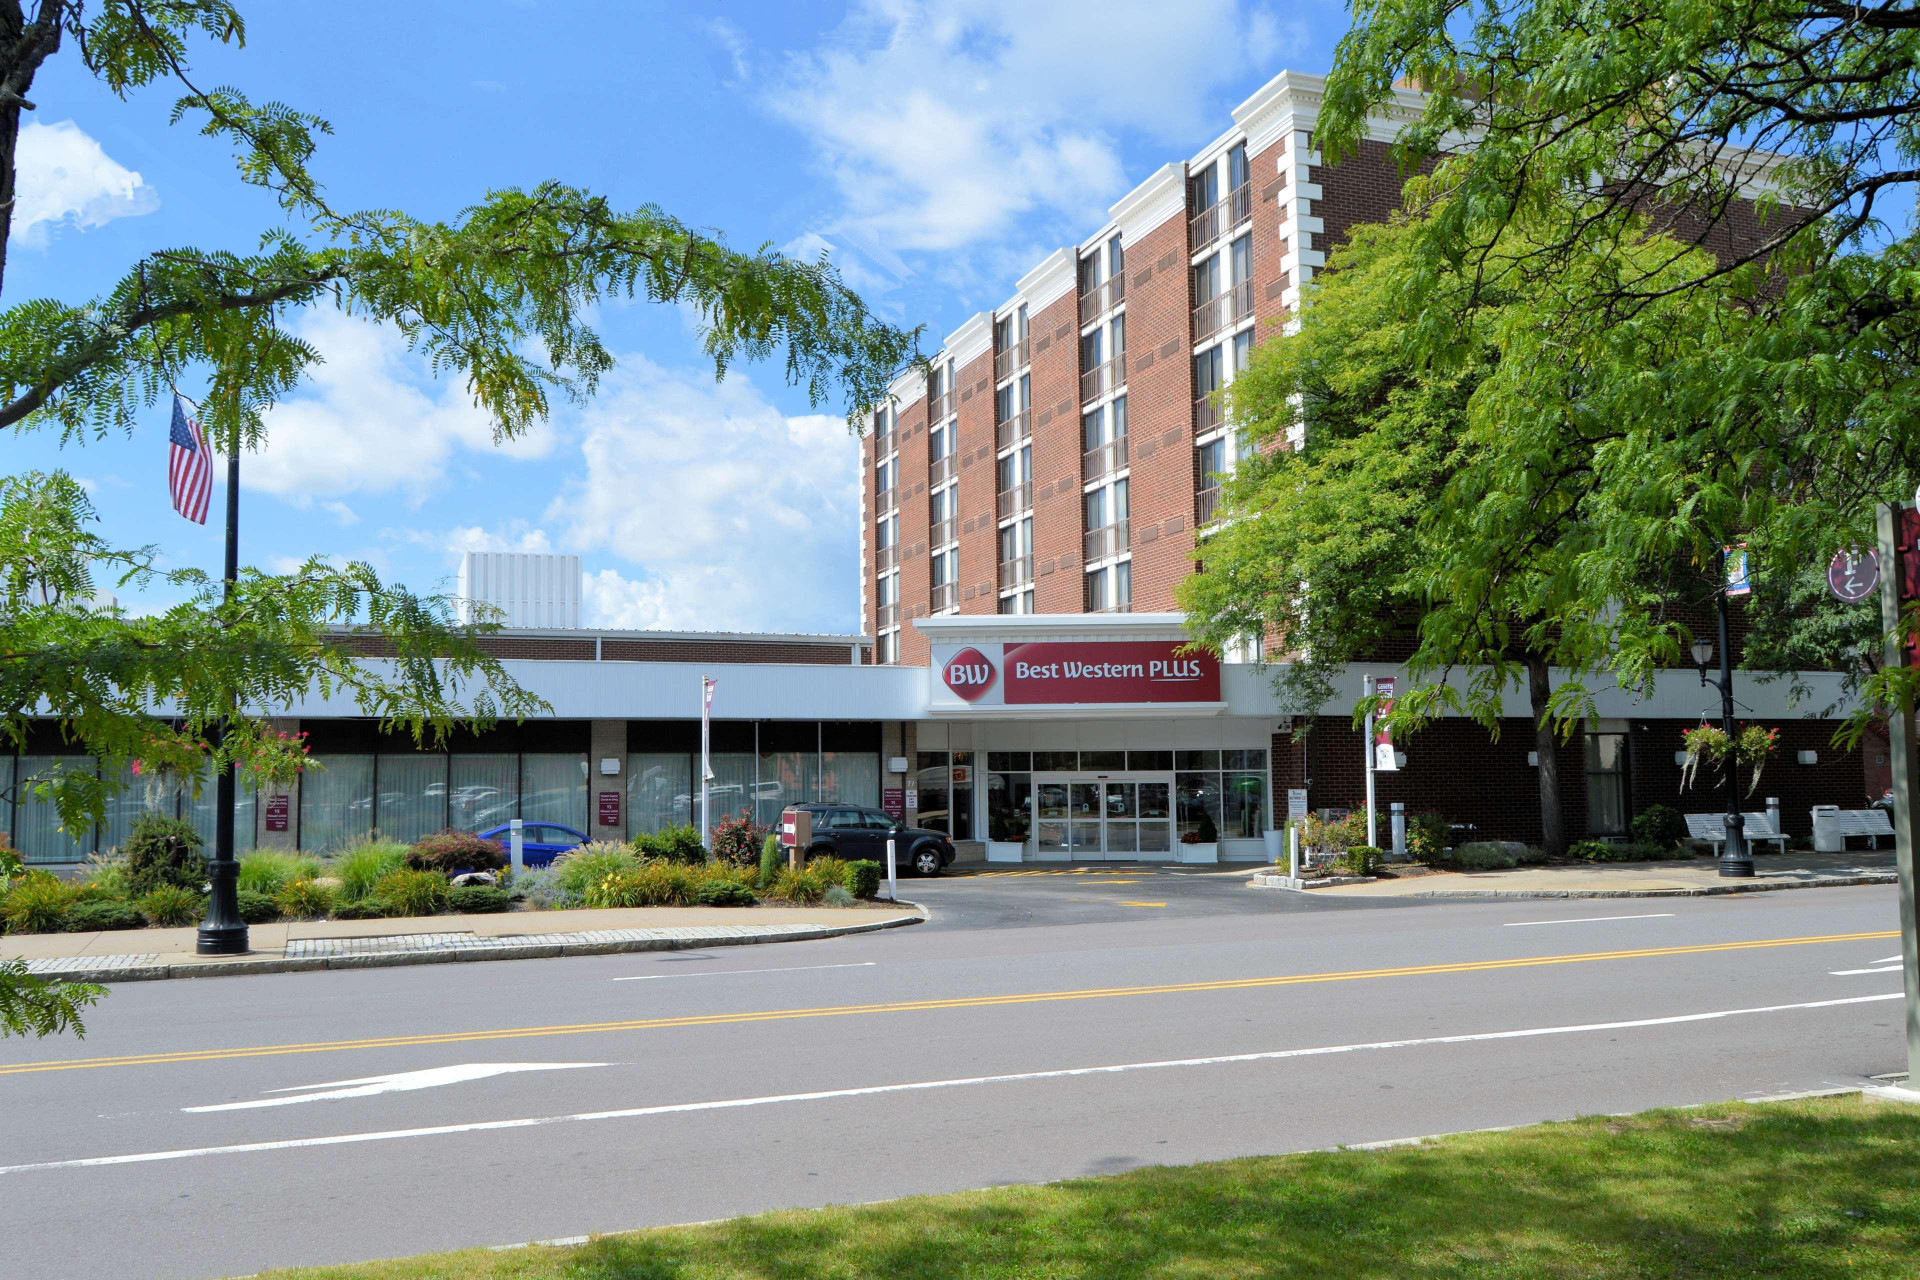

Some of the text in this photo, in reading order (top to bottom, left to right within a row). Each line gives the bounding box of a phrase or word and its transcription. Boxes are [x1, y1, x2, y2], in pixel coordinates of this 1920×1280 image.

[950, 664, 989, 685] BW
[1016, 659, 1201, 679] Best Western PLUS
